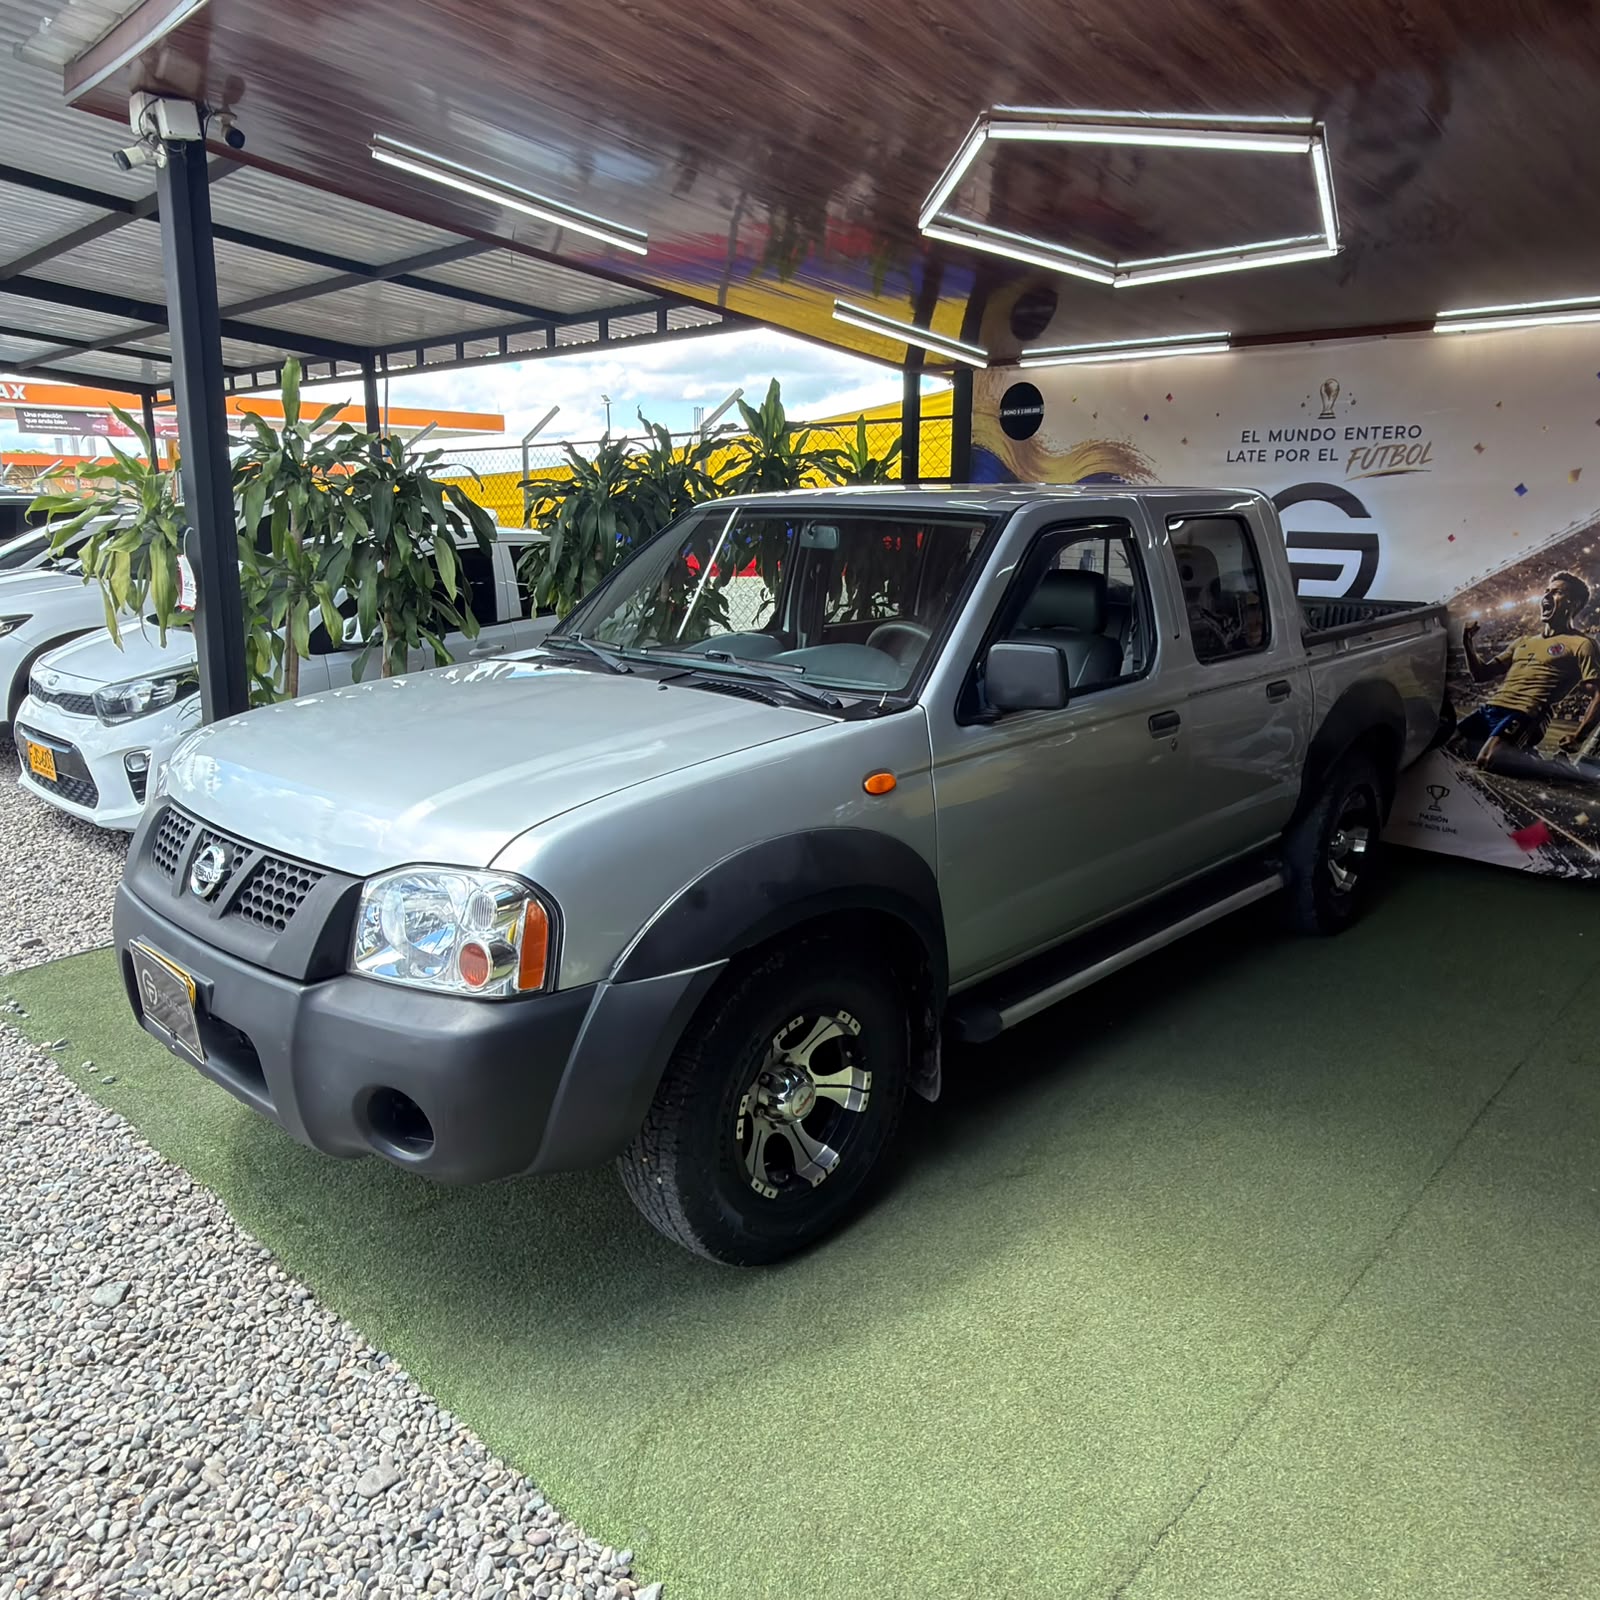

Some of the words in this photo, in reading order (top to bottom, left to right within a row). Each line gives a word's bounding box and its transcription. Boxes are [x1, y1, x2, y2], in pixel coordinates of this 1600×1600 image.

[1241, 430, 1260, 443] EL
[1269, 427, 1336, 443] MUNDO
[1344, 425, 1422, 440] ENTERO
[1226, 450, 1267, 463] LATE
[1275, 449, 1310, 462] POR
[1318, 448, 1339, 461] EL
[1345, 441, 1433, 474] FÚTBOL
